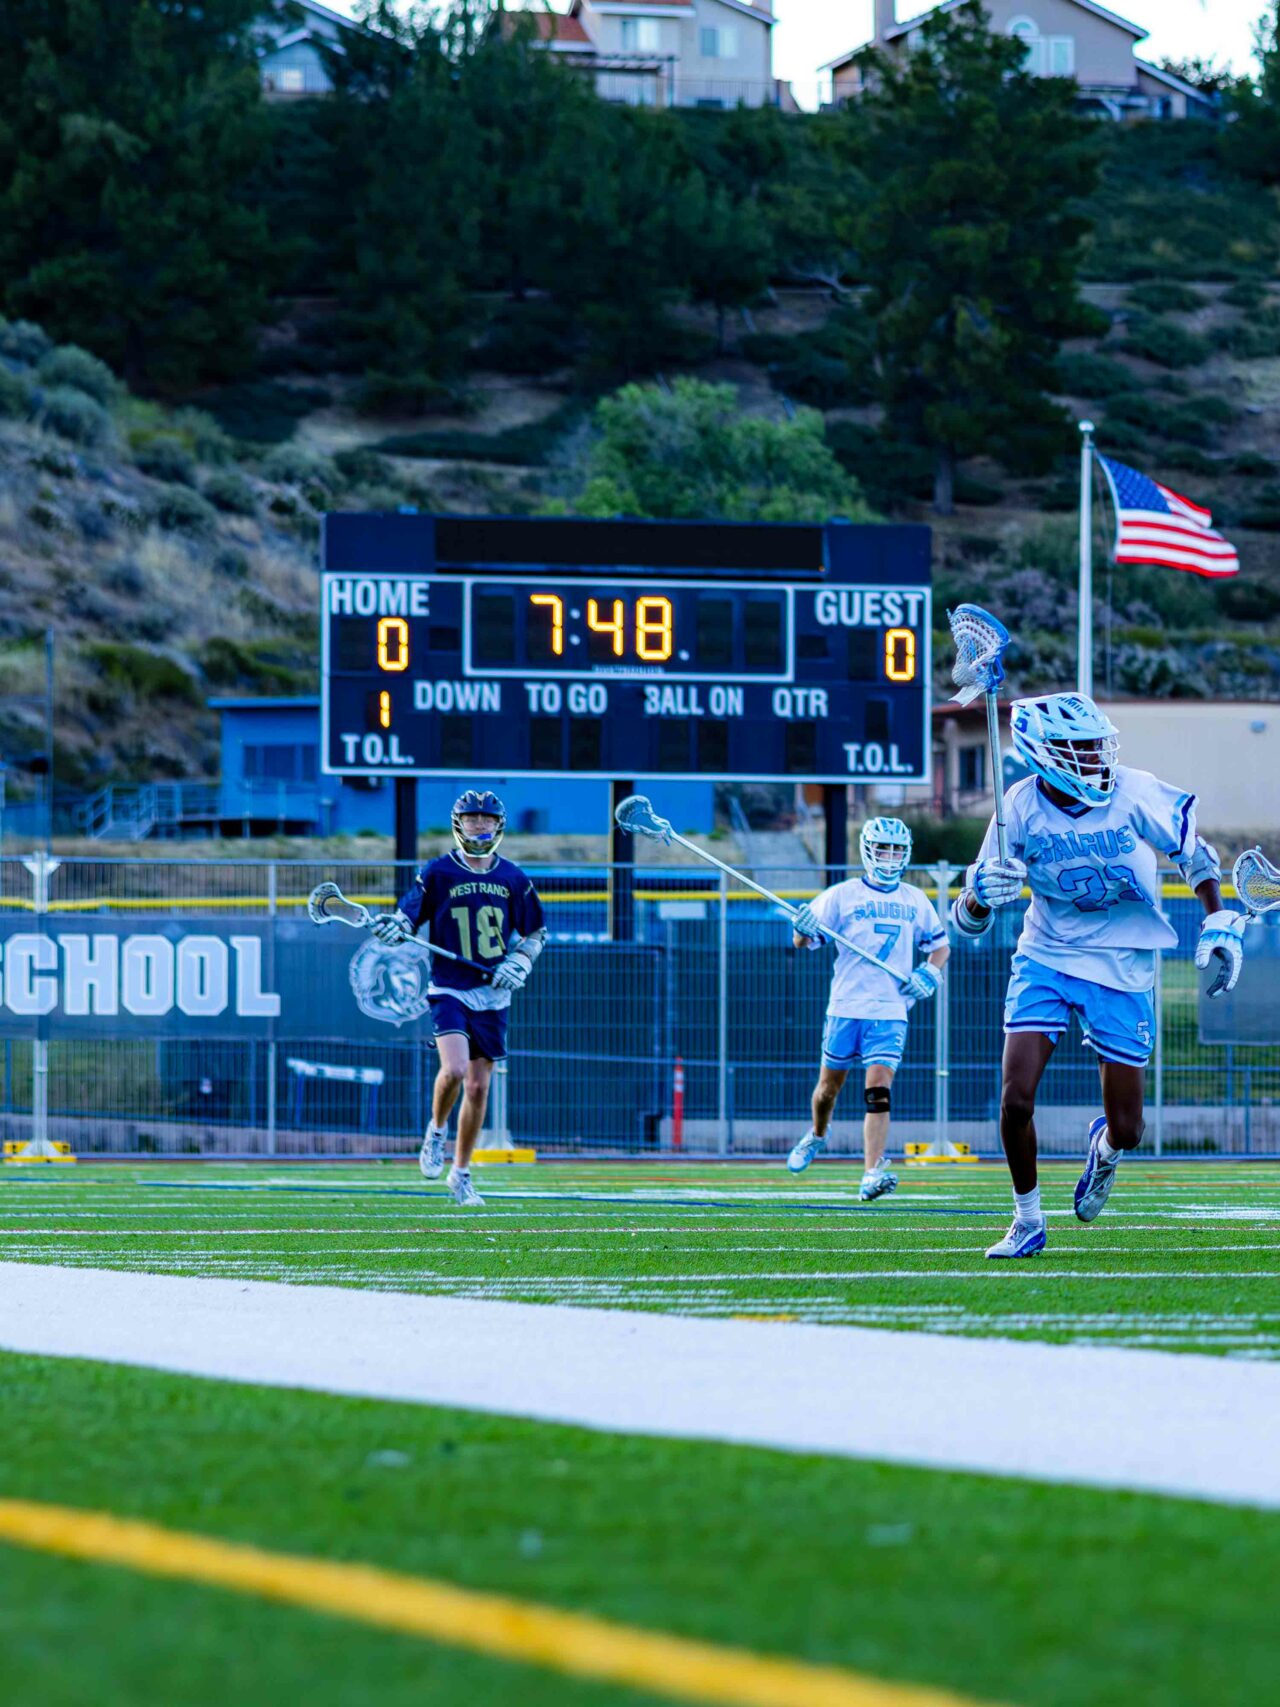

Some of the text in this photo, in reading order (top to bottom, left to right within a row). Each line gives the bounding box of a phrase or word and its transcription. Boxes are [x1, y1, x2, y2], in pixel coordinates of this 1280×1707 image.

[331, 580, 430, 616] HOME
[815, 591, 923, 627] GUEST
[378, 618, 409, 671] 0
[885, 628, 915, 681] 0
[379, 691, 391, 728] 1
[413, 681, 501, 712] DOWN
[525, 683, 608, 714] TO GO
[709, 687, 744, 717] ON
[772, 688, 829, 720] QTR
[842, 742, 914, 773] T.O.L.
[449, 882, 478, 899] WEST
[451, 905, 505, 961] 18
[873, 923, 902, 962] 7
[0, 933, 281, 1017] CHOOL
